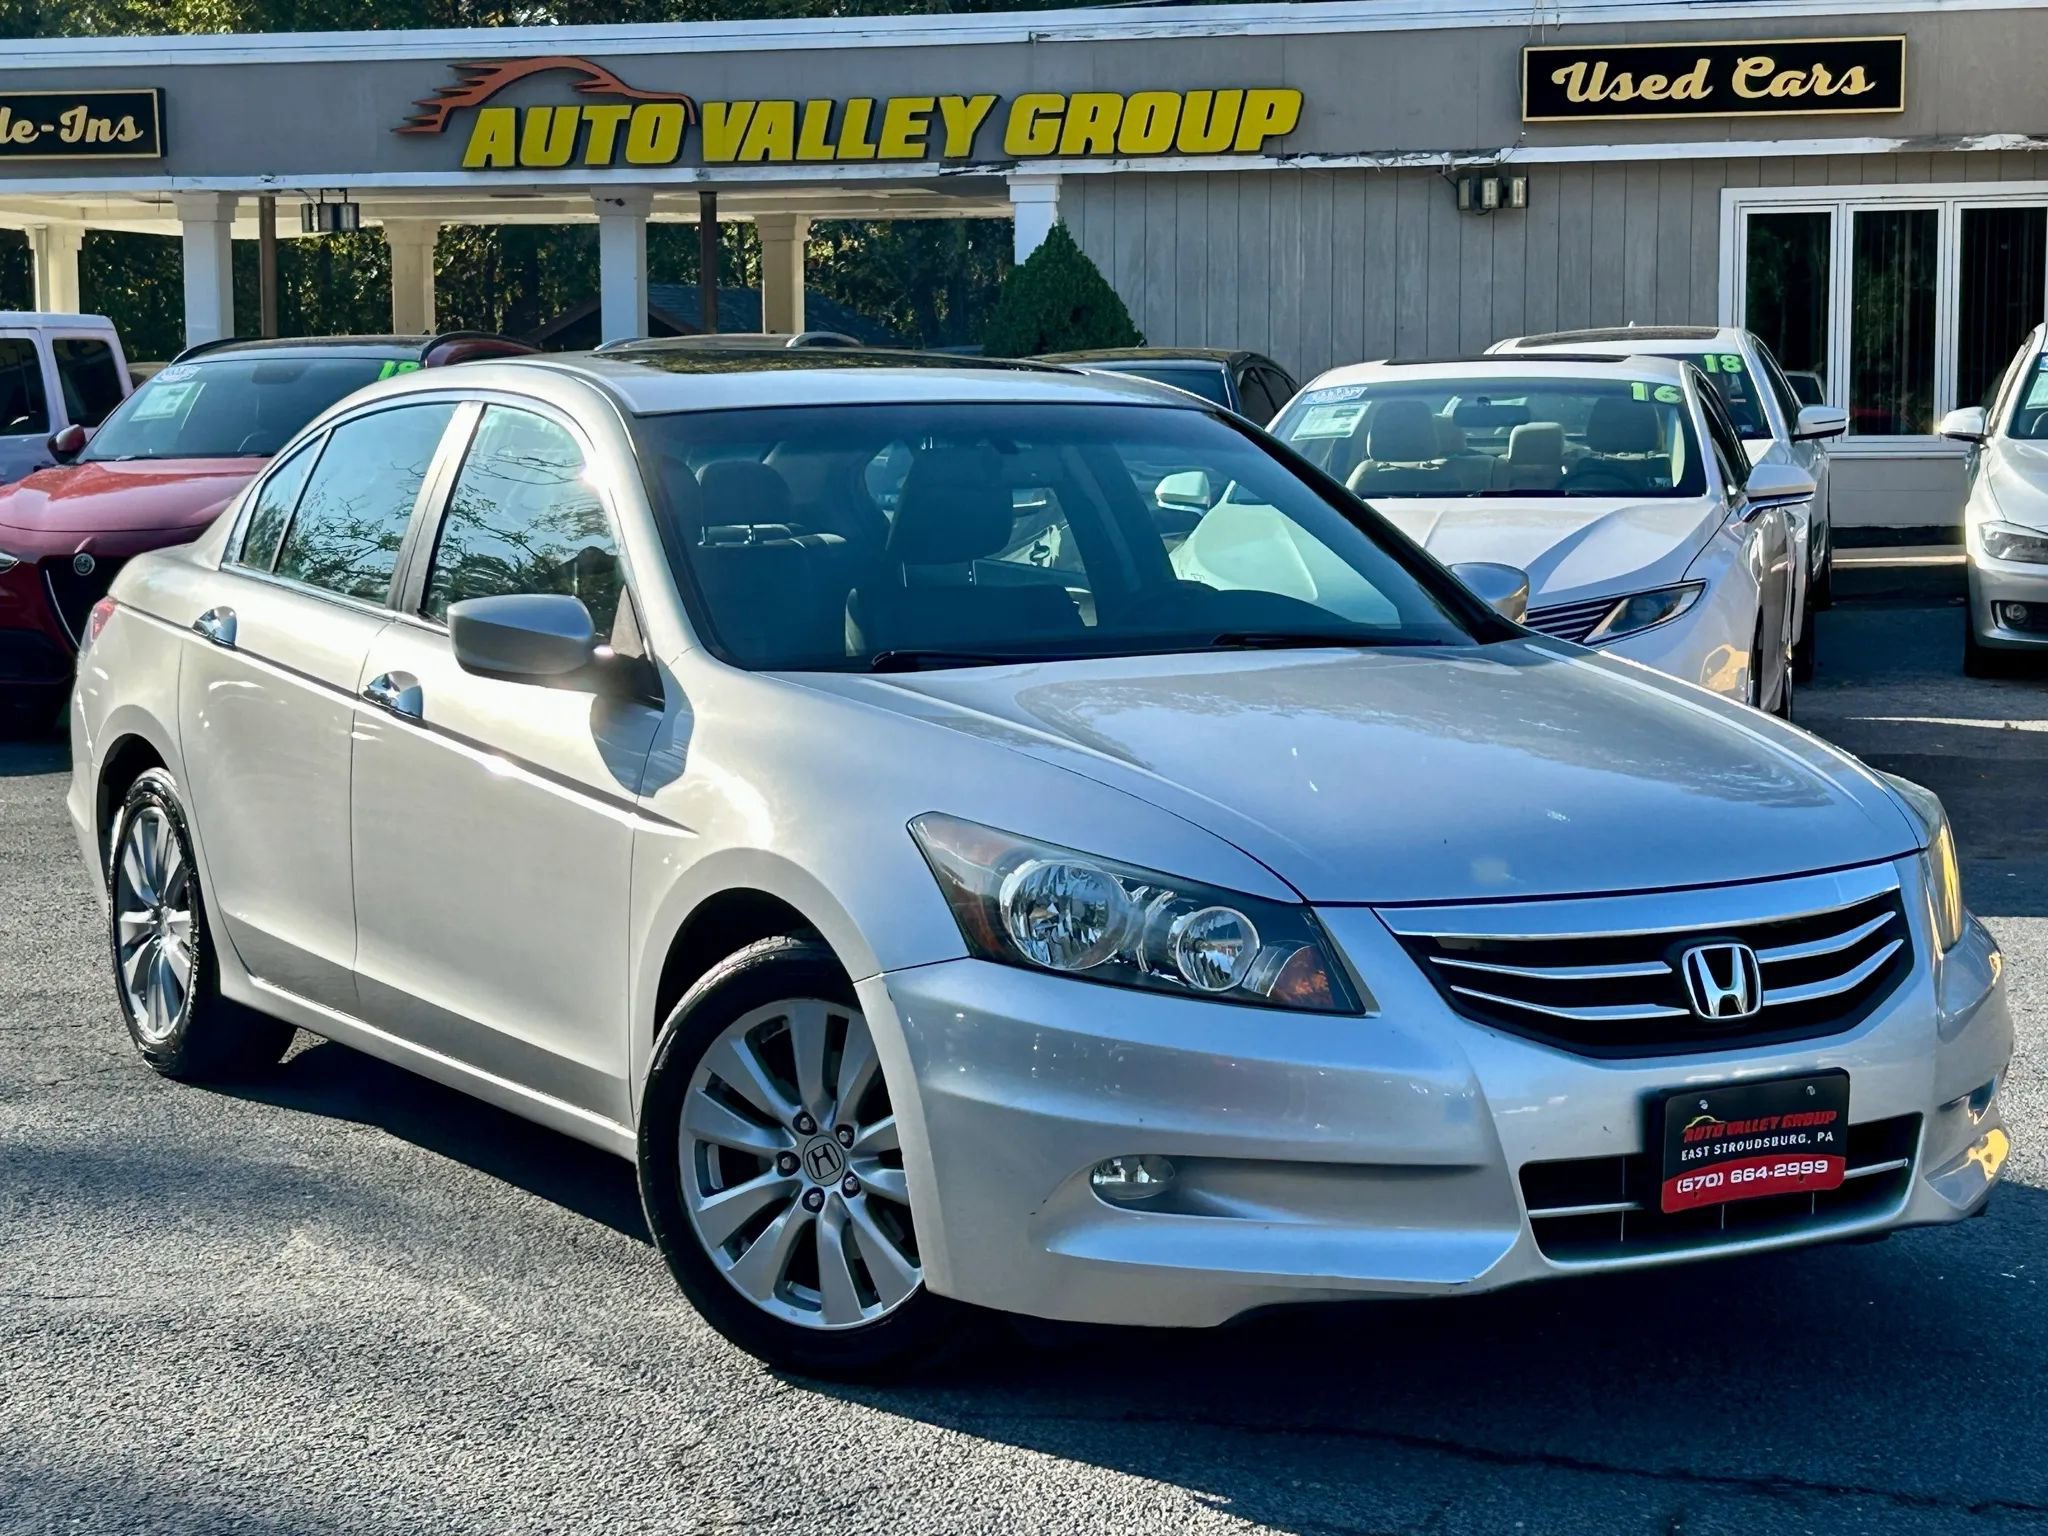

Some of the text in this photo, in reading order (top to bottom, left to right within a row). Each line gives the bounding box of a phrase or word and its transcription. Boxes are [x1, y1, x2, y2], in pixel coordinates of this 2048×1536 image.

[1551, 56, 1876, 102] Used Cars
[462, 88, 1303, 168] AUTO VALLEY GROUP
[1703, 354, 1743, 373] 18
[1631, 382, 1682, 404] 16
[1683, 1110, 1838, 1143] AUTO VALLEY GROUP
[1681, 1131, 1834, 1161] EAST STROUDSBURG, PA
[1676, 1173, 1724, 1194] (570)
